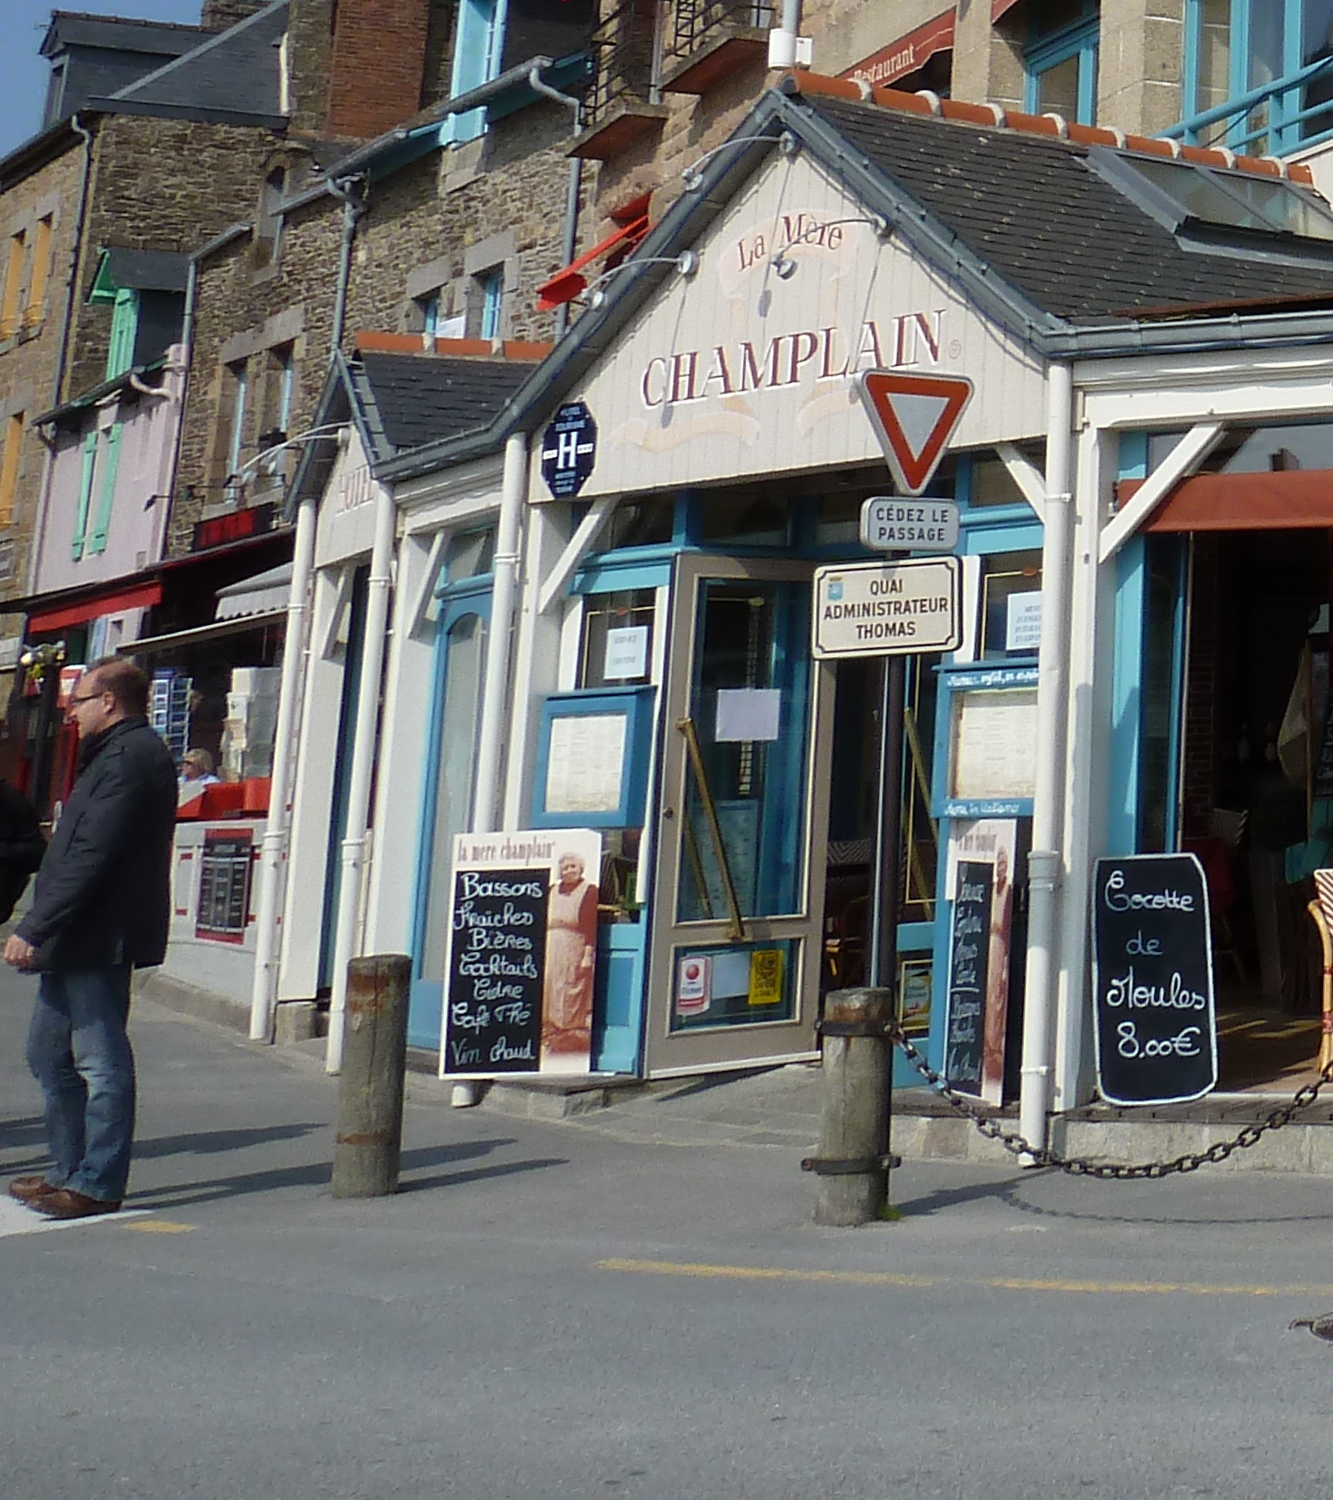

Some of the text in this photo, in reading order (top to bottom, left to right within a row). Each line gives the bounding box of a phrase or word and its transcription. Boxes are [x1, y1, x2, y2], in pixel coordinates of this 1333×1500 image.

[737, 213, 843, 272] La Mère
[642, 309, 947, 408] CHAMPLAIN
[556, 431, 579, 469] H
[876, 504, 949, 523] CÉDEZ LE
[878, 527, 946, 542] PASSAGE
[870, 579, 903, 596] QUAI
[824, 597, 949, 620] ADMINISTRATEUR
[856, 621, 916, 640] THOMAS
[459, 838, 467, 861] la
[501, 835, 553, 866] champlain
[1105, 870, 1195, 912] Cocotte
[468, 929, 533, 950] Bières
[1126, 930, 1163, 955] de
[459, 952, 538, 979] Cocktails
[474, 978, 524, 1000] Cidre
[1106, 965, 1206, 1010] Moules
[495, 1002, 532, 1026] Thé
[451, 1038, 482, 1066] Vin
[1117, 1021, 1201, 1060] 8.00€
